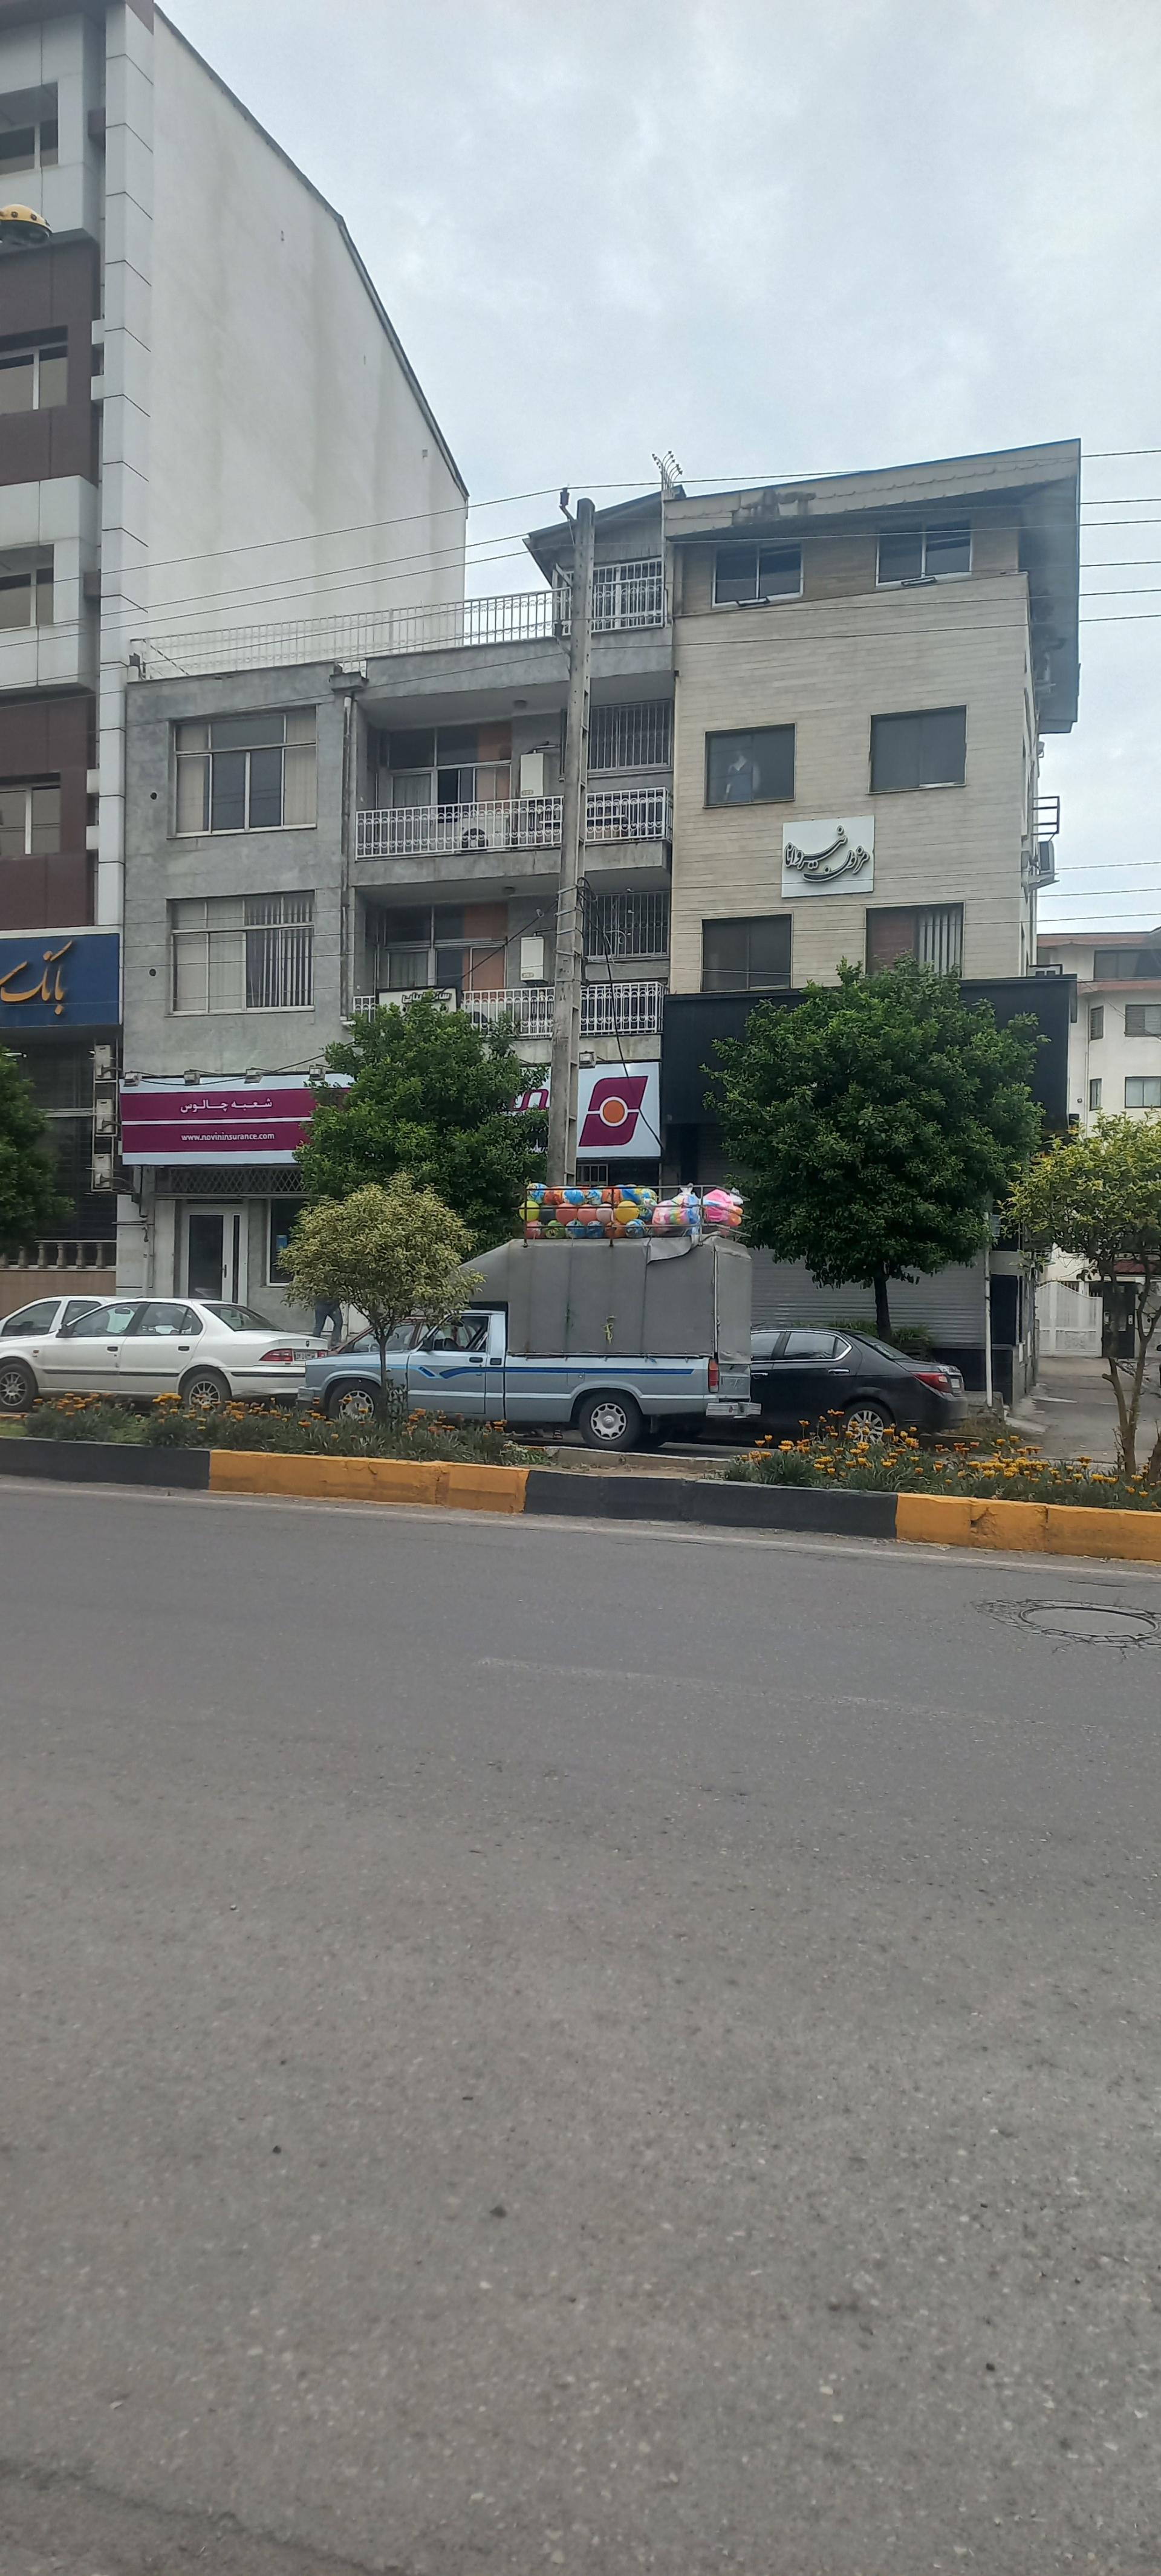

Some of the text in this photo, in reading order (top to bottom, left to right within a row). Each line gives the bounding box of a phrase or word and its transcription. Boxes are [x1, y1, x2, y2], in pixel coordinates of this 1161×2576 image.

[785, 825, 847, 870] نیروانا
[1, 940, 72, 1015] بانک
[180, 1098, 273, 1113] شعبه چالوس
[181, 1131, 275, 1141] www.novininsurance.com
